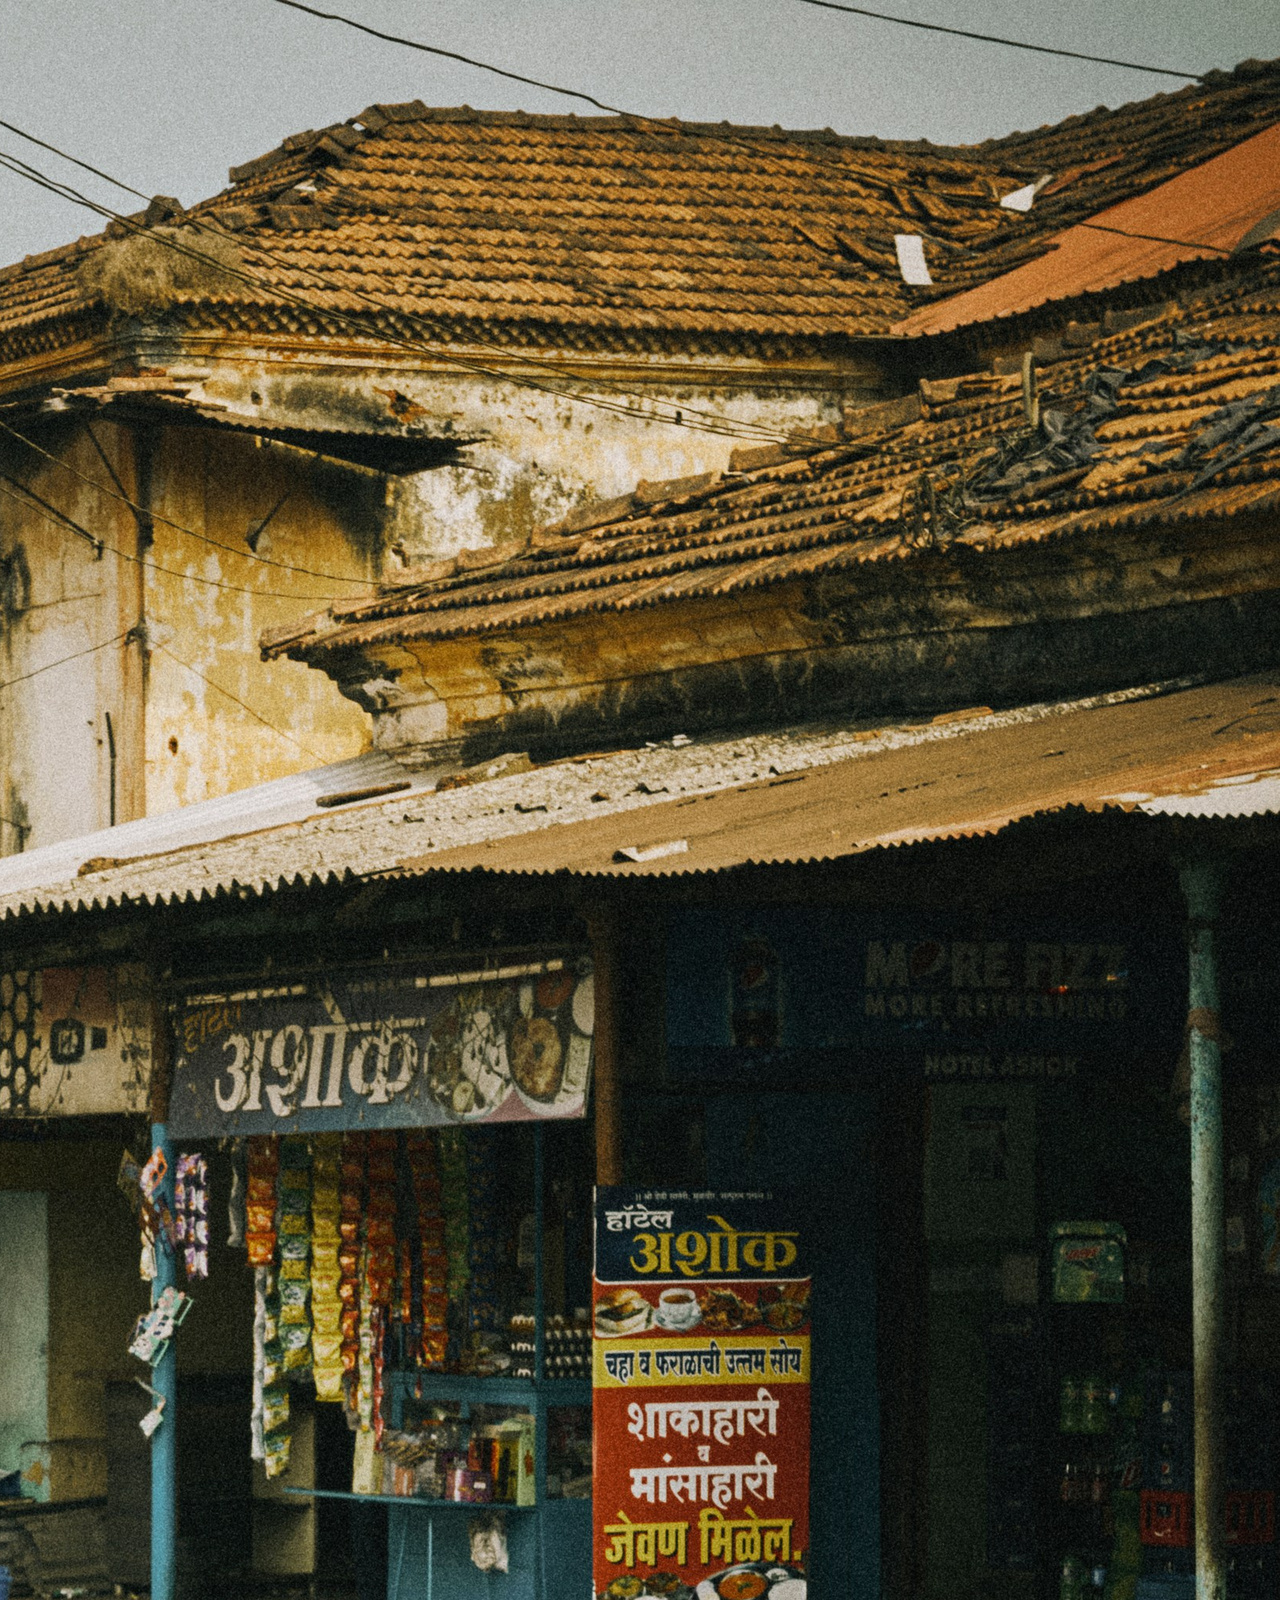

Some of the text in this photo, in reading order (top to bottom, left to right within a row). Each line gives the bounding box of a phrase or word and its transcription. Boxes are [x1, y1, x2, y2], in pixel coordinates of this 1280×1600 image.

[864, 994, 1128, 1020] MORE REFRESHING
[215, 980, 426, 1117] अशोक
[924, 1054, 1078, 1078] HOTEL ASHOK
[605, 1204, 674, 1232] हॉटेल
[629, 1215, 799, 1277] अशोक
[605, 1339, 802, 1383] चहा व फराळाची उत्तम सोय
[627, 1387, 780, 1445] शाकाहारी
[697, 1445, 710, 1462] व
[629, 1452, 777, 1509] मांसाहारी
[604, 1509, 689, 1567] जेवण
